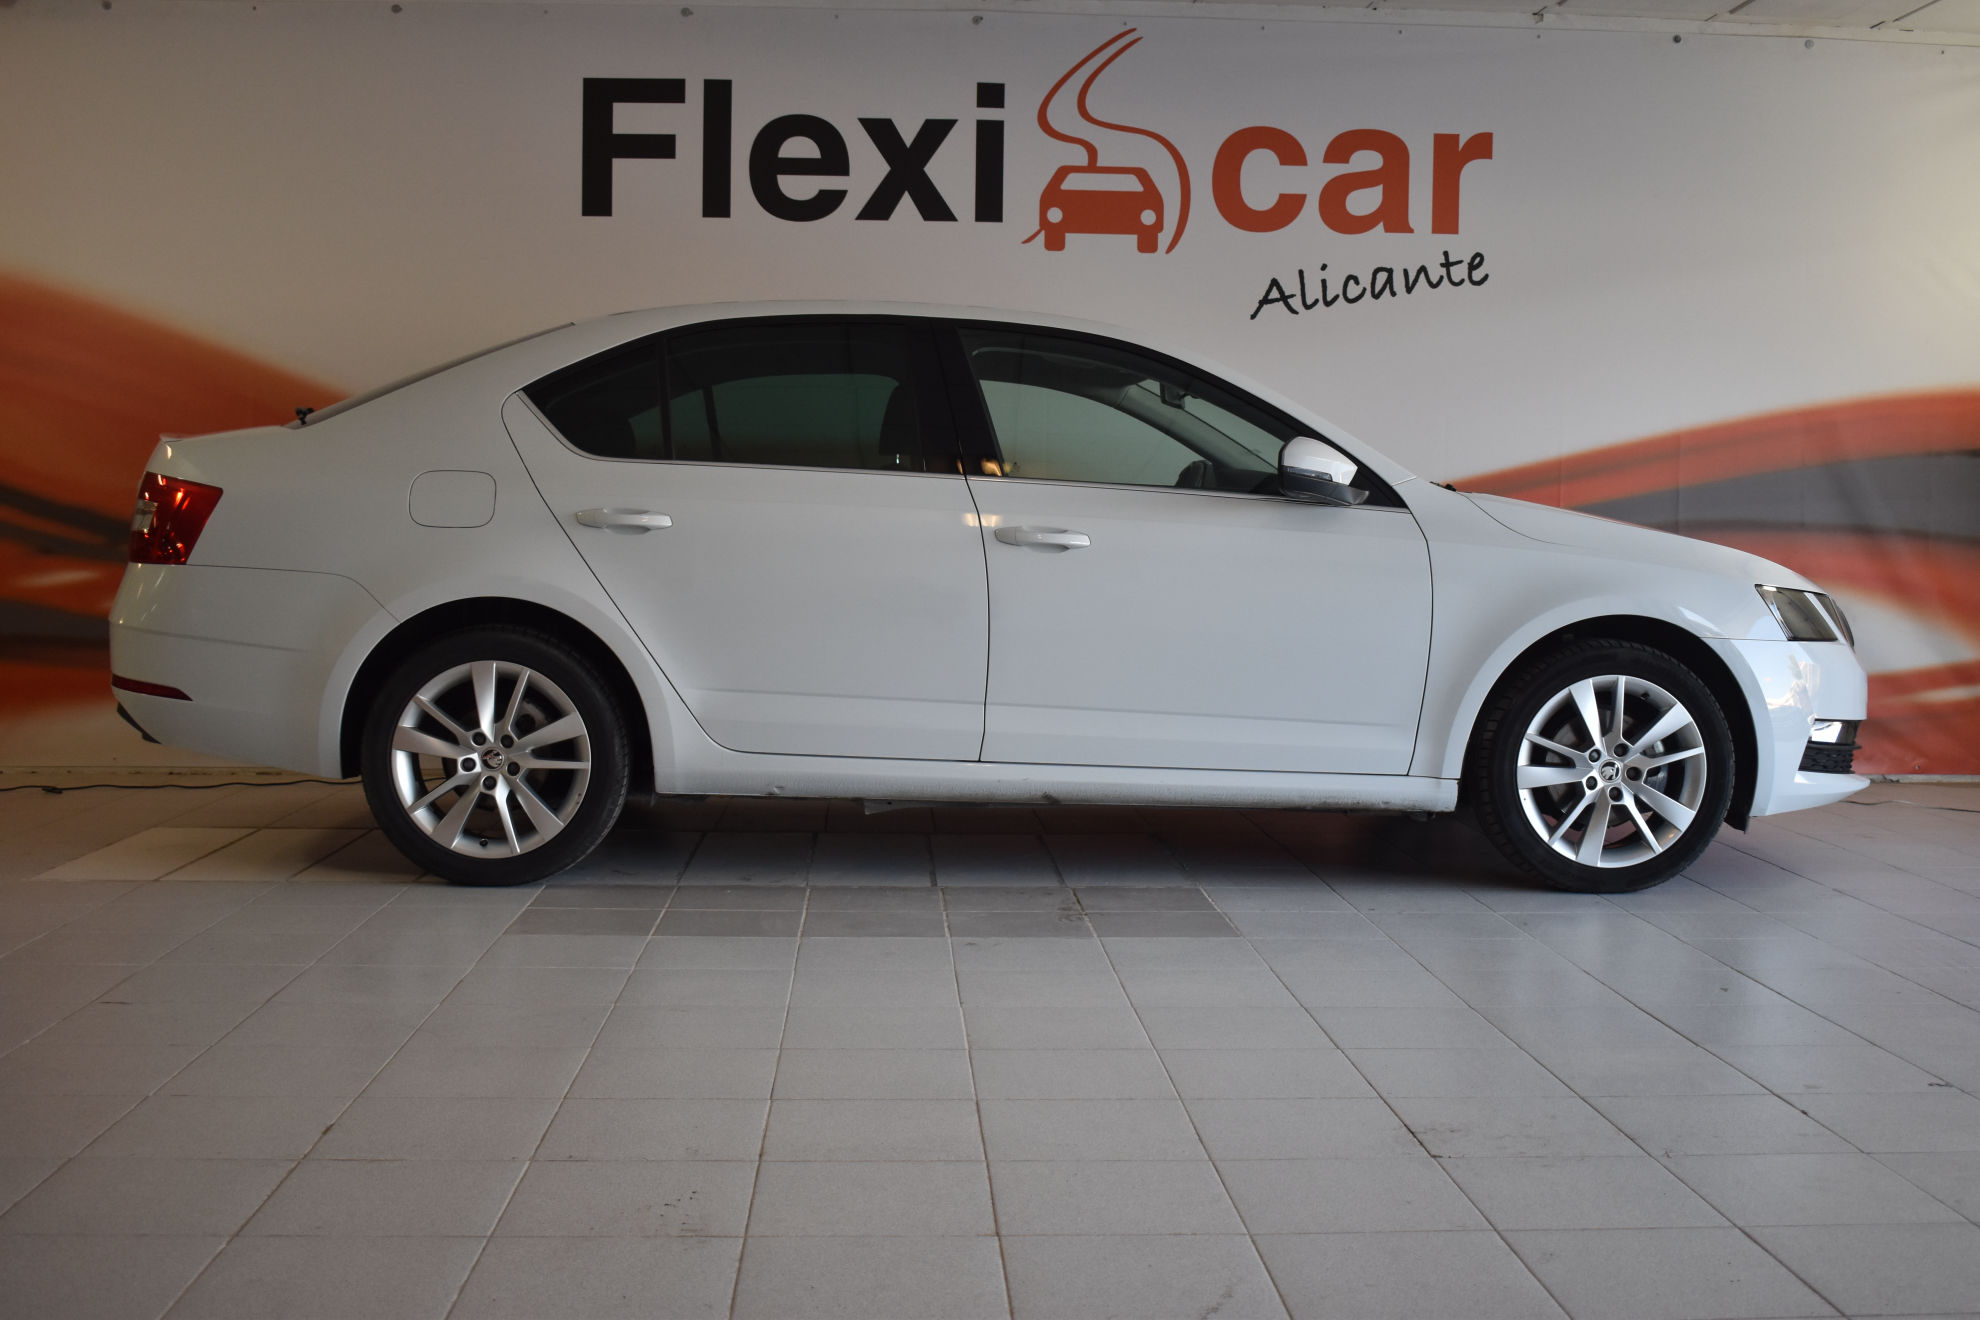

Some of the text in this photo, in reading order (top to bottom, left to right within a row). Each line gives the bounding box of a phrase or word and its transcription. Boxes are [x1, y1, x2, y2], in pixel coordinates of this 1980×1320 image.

[581, 77, 1494, 236] Flexi car
[1249, 249, 1490, 321] Alicante
